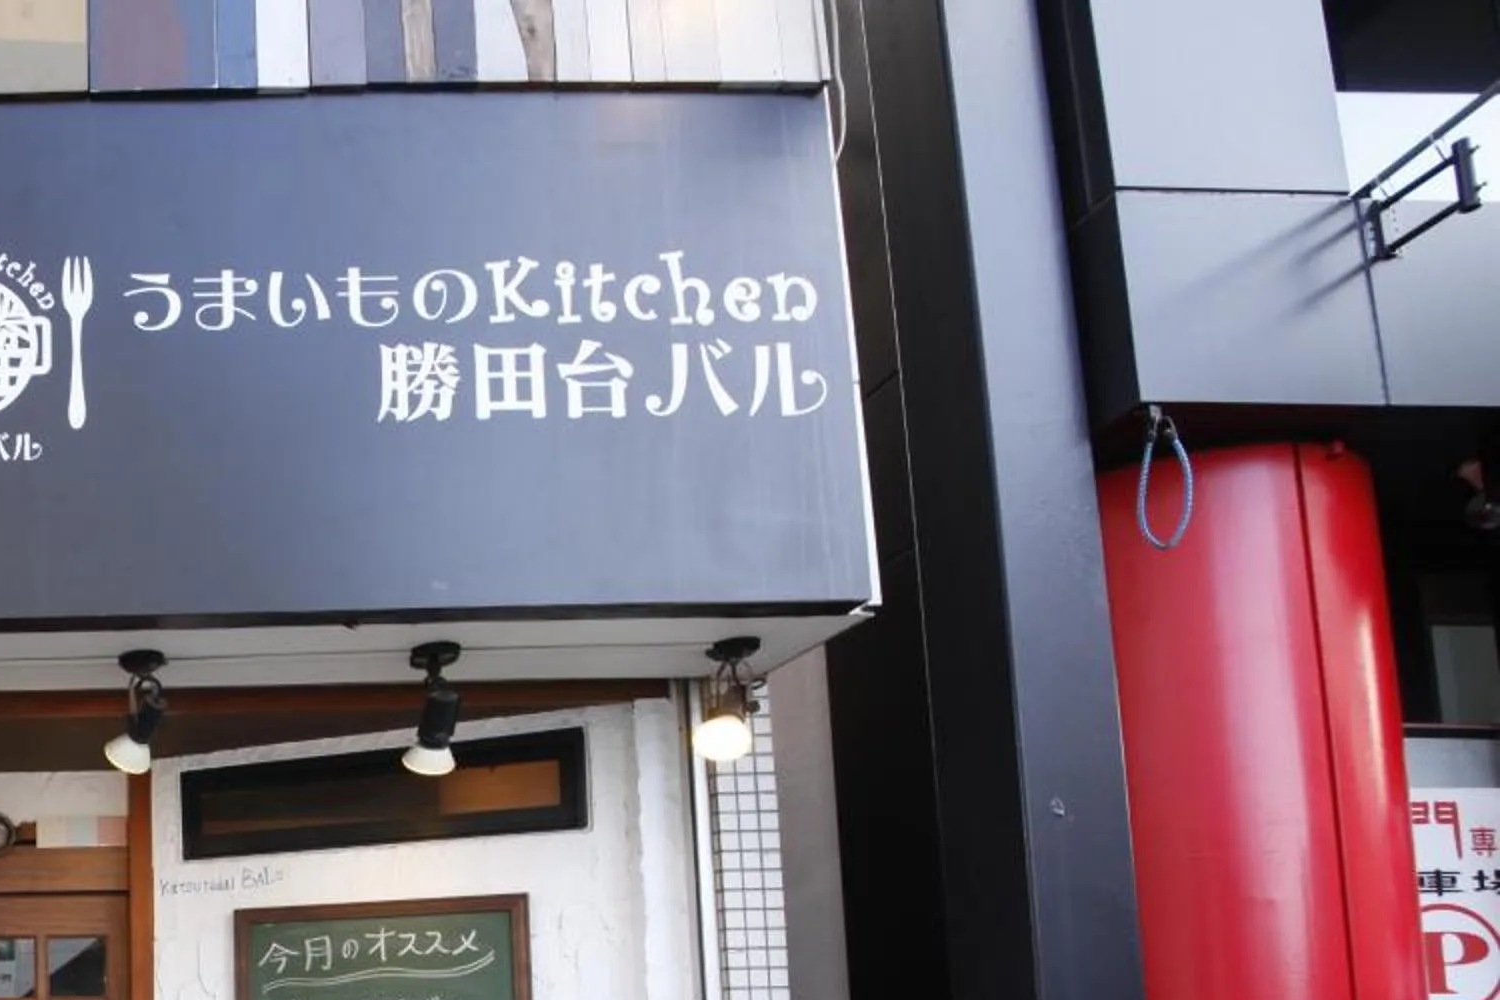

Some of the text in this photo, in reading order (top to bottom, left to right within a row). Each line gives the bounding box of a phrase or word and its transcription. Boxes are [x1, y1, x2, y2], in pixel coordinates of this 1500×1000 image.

[122, 251, 819, 332] うまいものKitchen
[376, 338, 828, 424] 勝田台バル
[258, 927, 480, 974] 今月のオススメ
[1424, 931, 1490, 996] P
